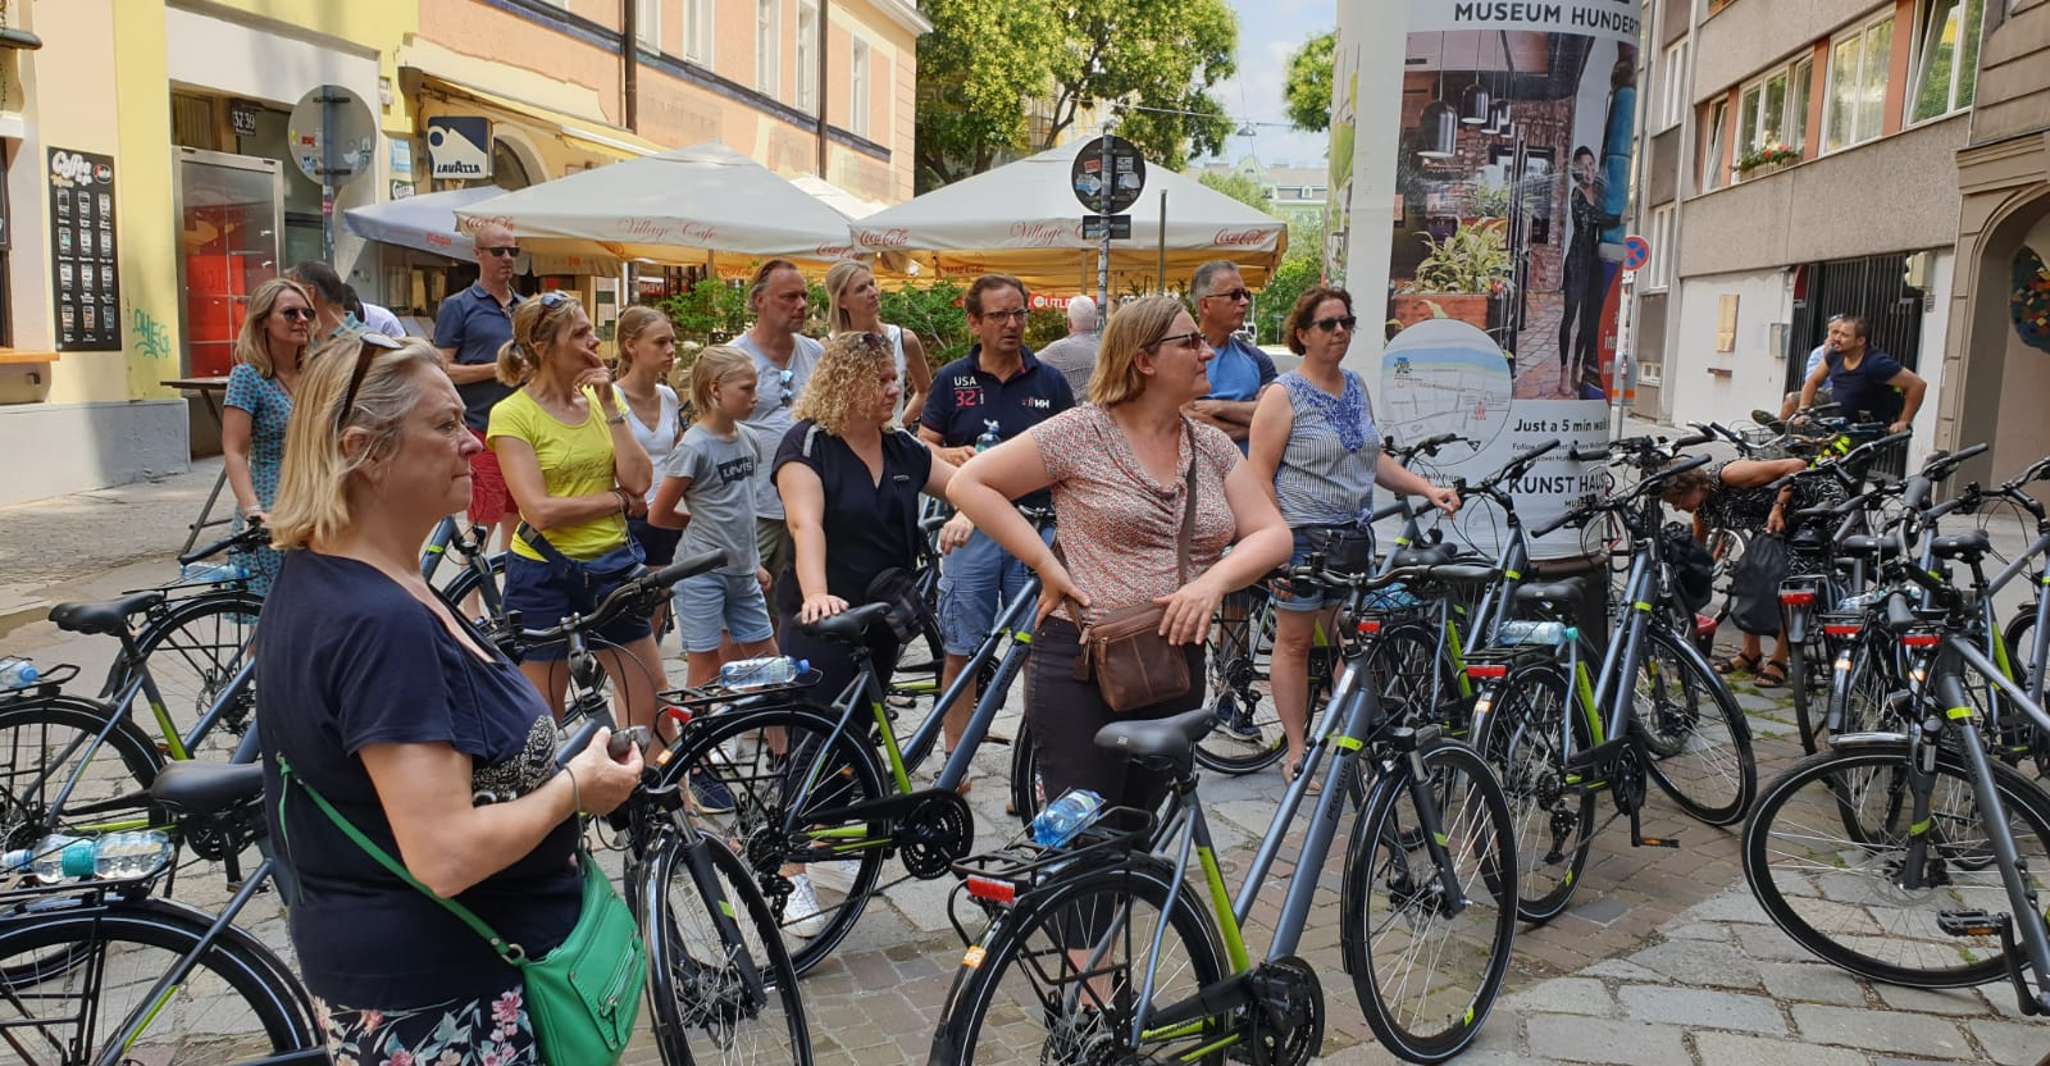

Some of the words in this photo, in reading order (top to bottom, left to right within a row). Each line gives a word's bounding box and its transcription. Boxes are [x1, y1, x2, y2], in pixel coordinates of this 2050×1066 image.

[1454, 3, 1561, 23] MUSEUM
[436, 160, 481, 174] LAVAZZA
[953, 376, 977, 386] USA
[954, 390, 977, 407] 32
[1514, 419, 1546, 432] Just
[1550, 421, 1558, 432] a
[1561, 419, 1570, 432] 5
[1572, 419, 1592, 432] min
[1508, 476, 1575, 494] KUNST
